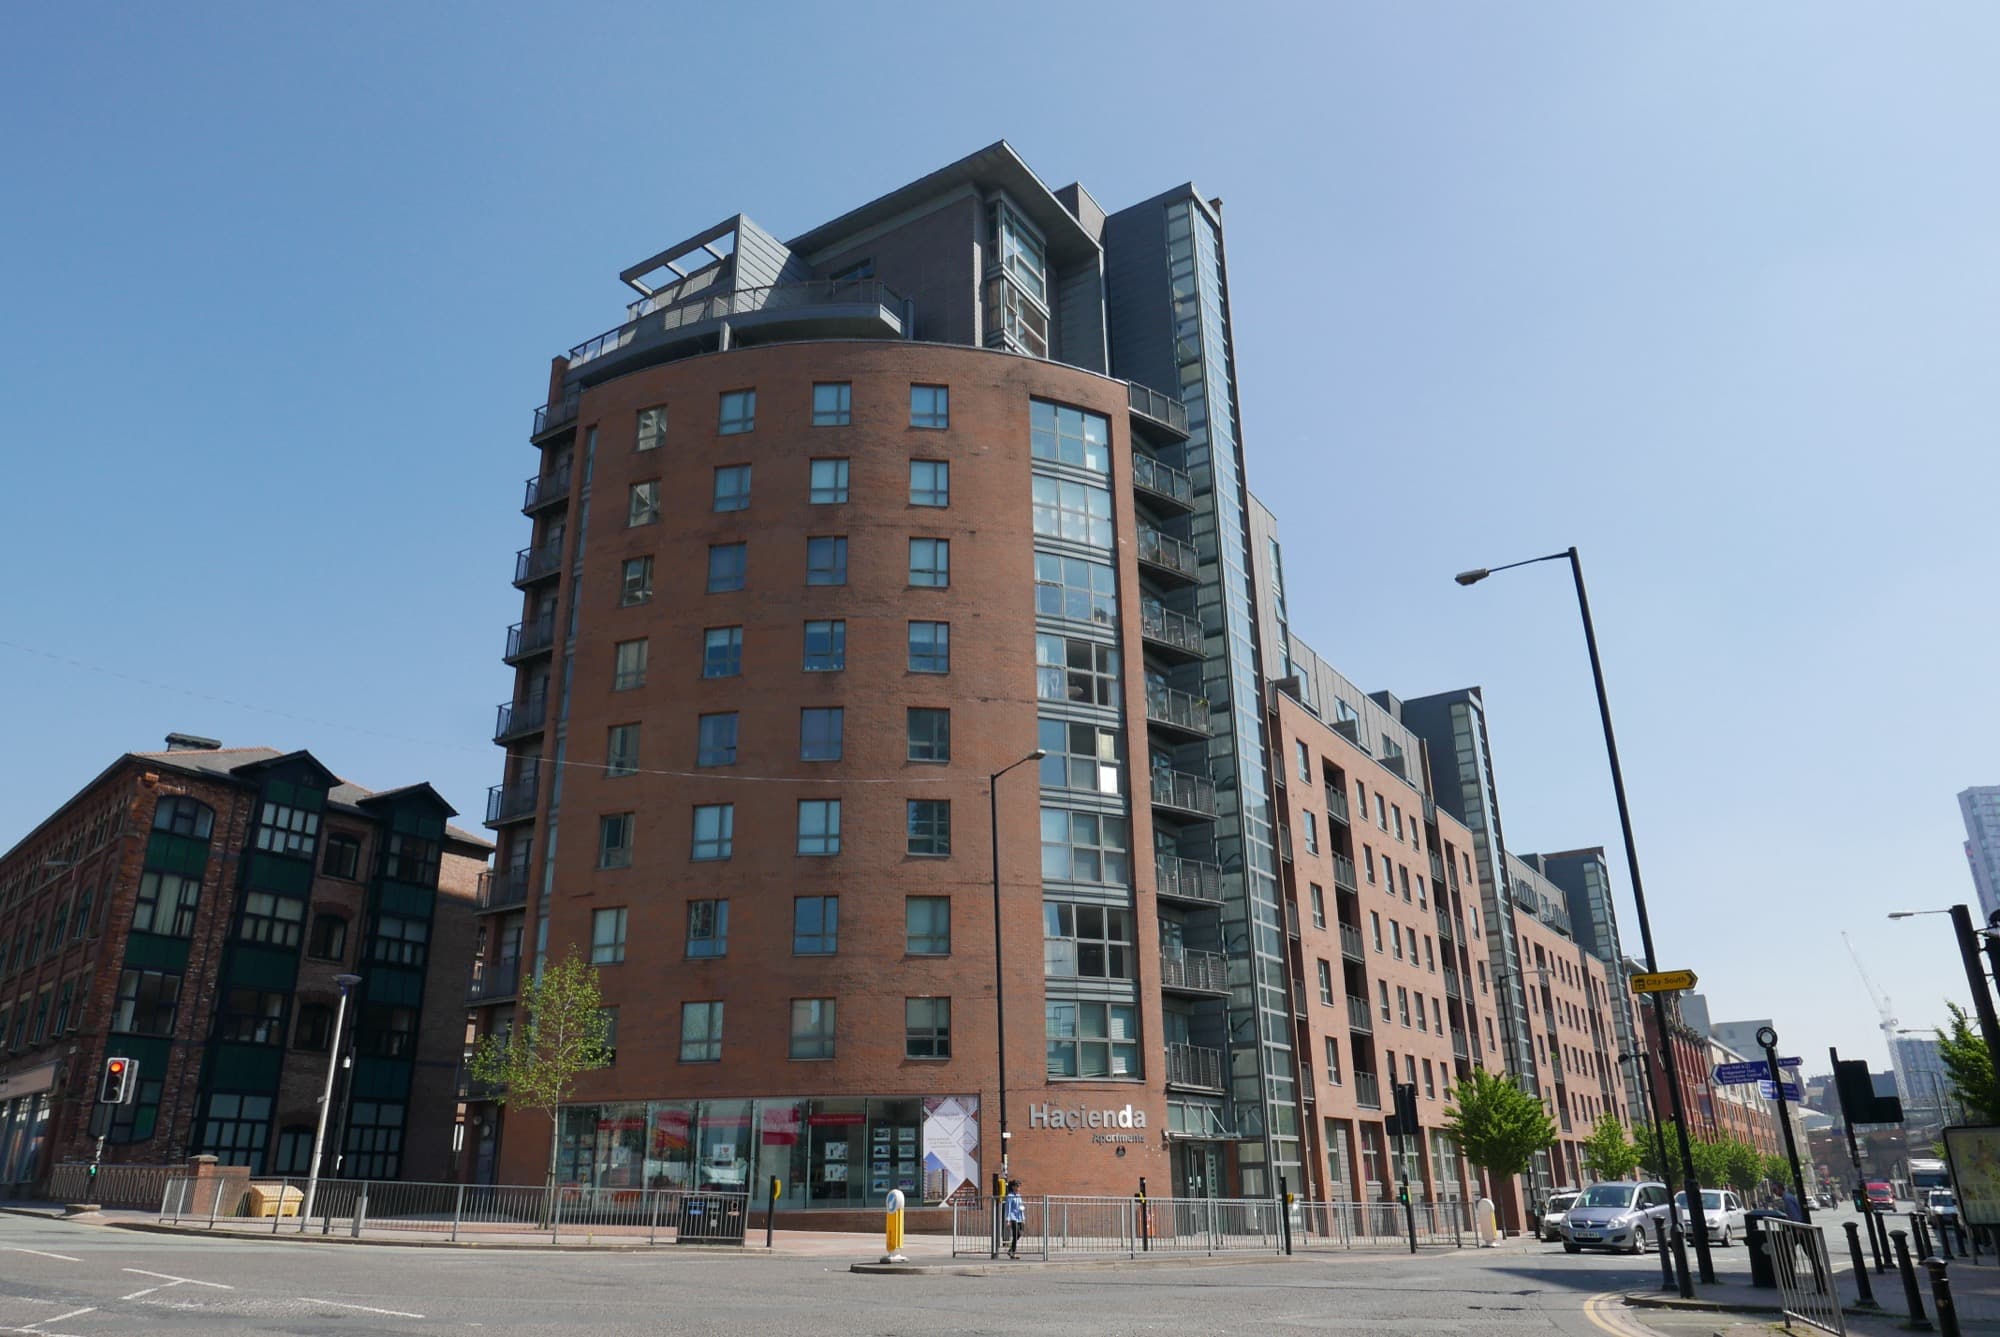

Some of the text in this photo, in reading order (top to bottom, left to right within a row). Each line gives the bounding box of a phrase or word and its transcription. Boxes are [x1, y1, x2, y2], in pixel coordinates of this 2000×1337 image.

[1646, 975, 1687, 986] City South
[1029, 1103, 1147, 1135] Haçienda
[1092, 1133, 1145, 1145] Apartments
